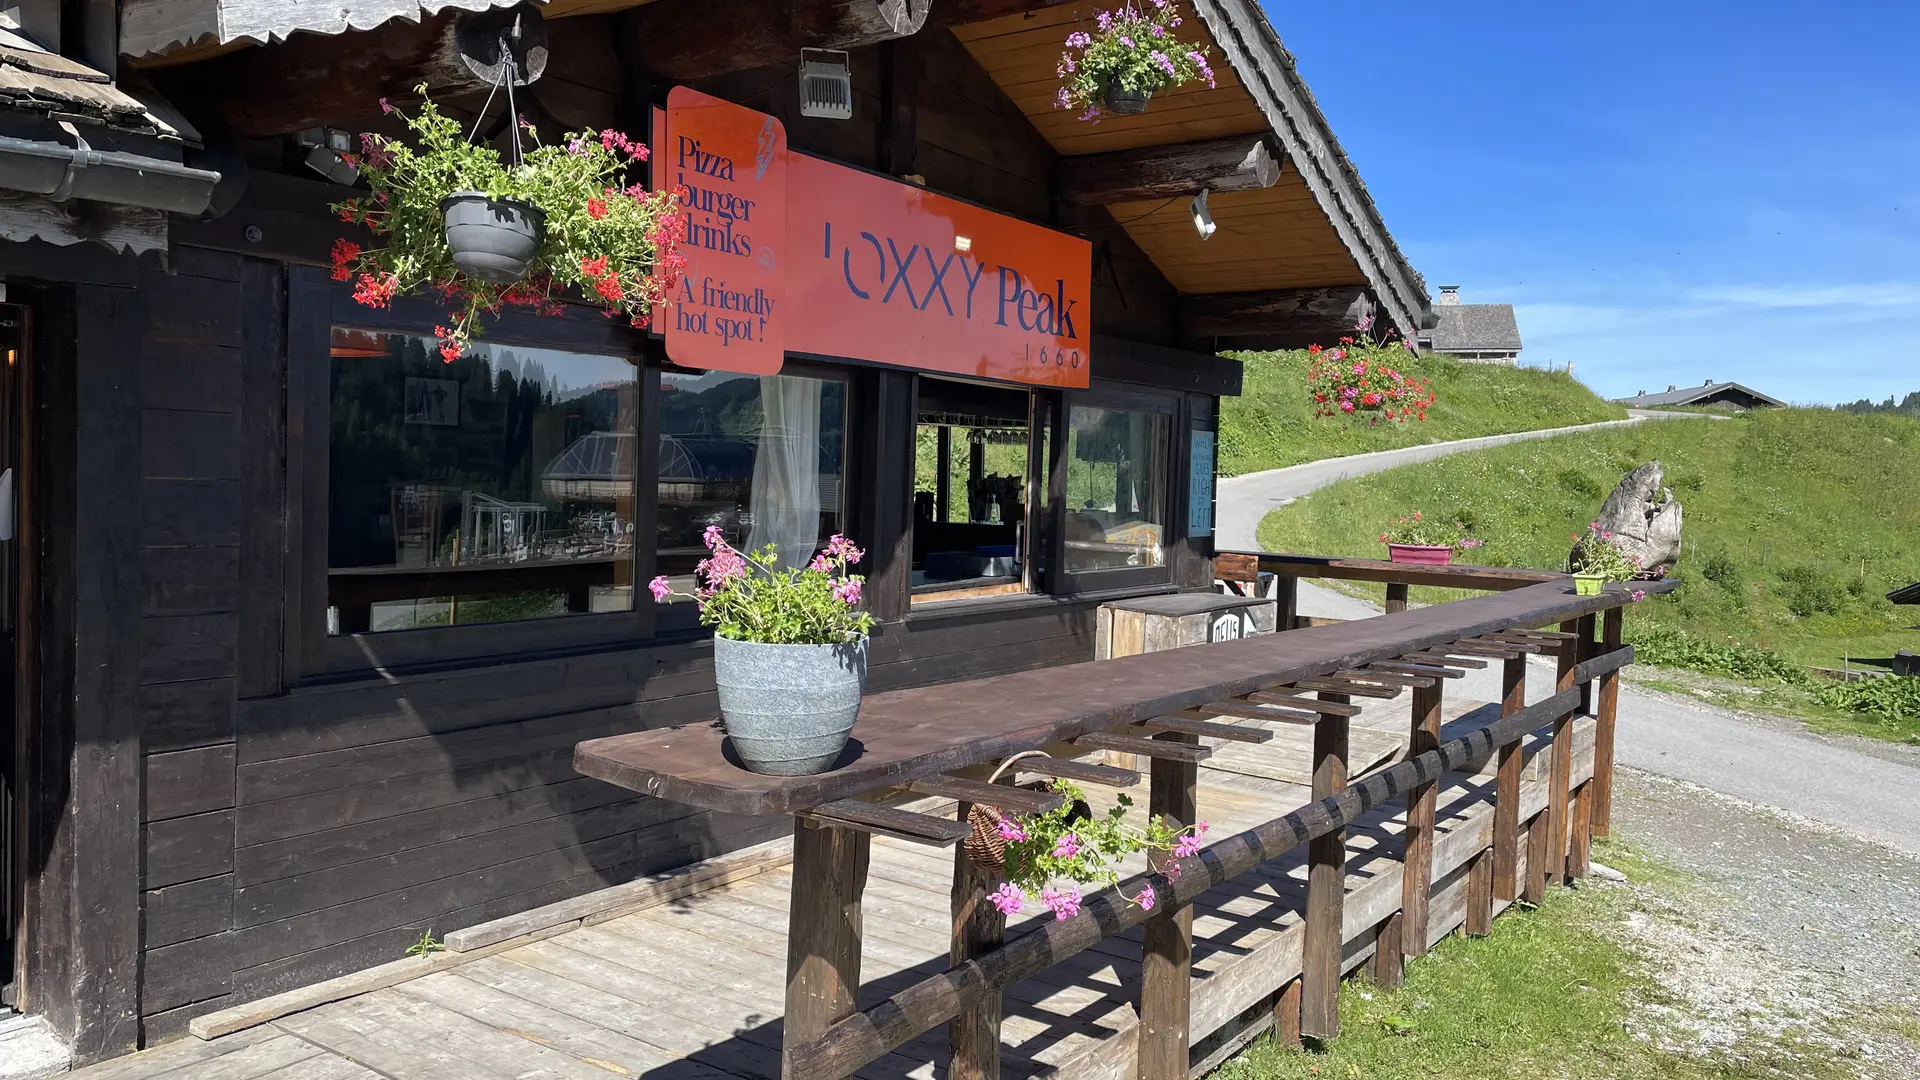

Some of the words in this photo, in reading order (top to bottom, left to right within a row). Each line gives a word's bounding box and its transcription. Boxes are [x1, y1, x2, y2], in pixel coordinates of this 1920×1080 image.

[678, 135, 735, 182] Pizza
[677, 173, 755, 227] burger
[681, 212, 752, 257] drinks
[676, 275, 696, 304] A
[702, 277, 775, 323] friendly
[676, 302, 709, 335] hot
[995, 265, 1078, 340] Peak
[1025, 342, 1079, 369] 1660
